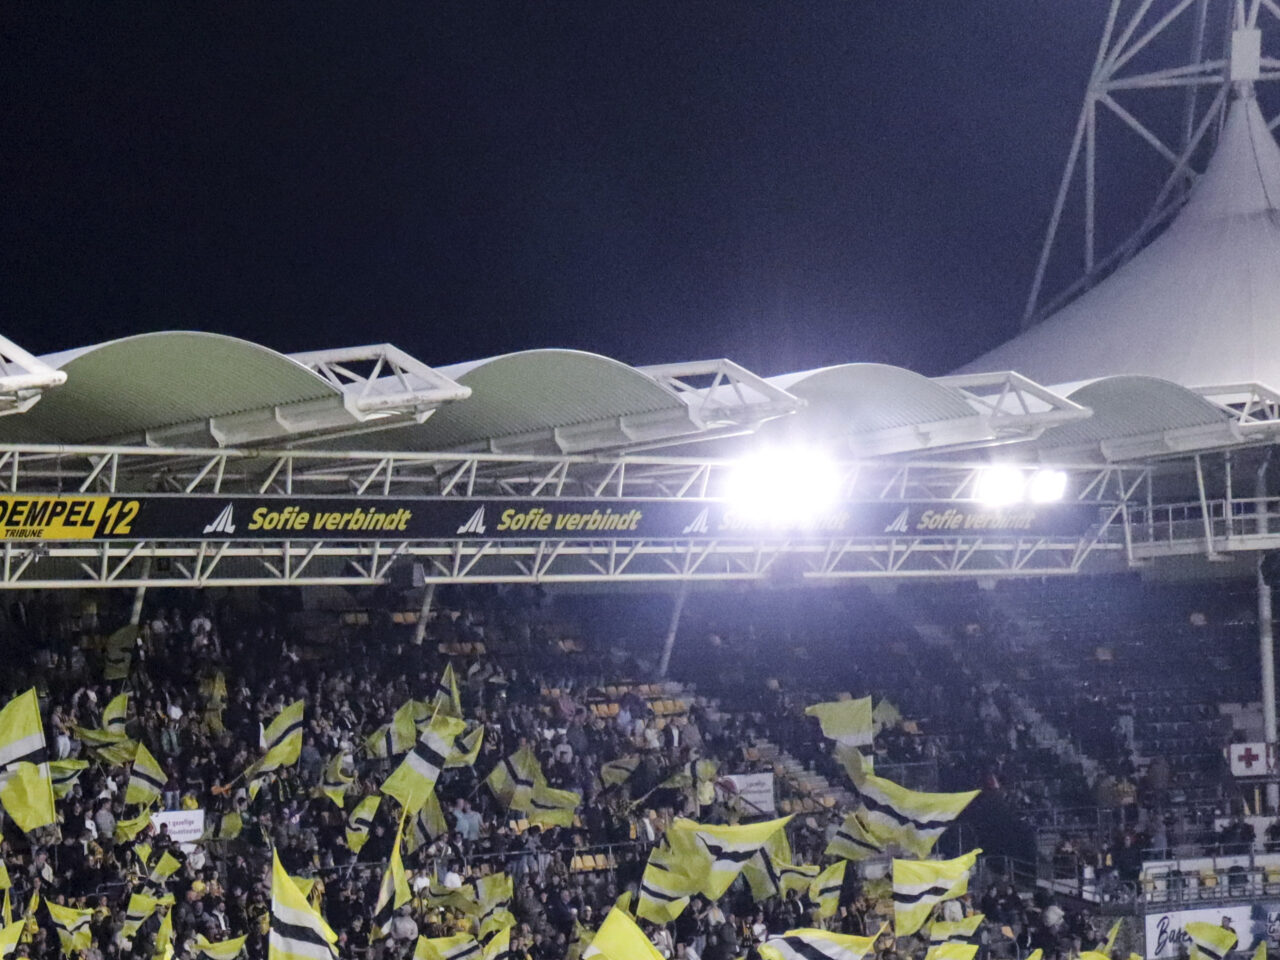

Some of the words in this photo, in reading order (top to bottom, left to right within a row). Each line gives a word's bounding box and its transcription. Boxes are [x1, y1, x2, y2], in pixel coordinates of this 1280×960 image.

[102, 500, 140, 534] 12
[247, 507, 308, 532] Sofie
[312, 507, 412, 532] verbindt
[497, 507, 553, 532] Sofie
[555, 507, 643, 532] verbindt
[917, 510, 962, 530] Sofie
[4, 528, 44, 538] TRIBUNE
